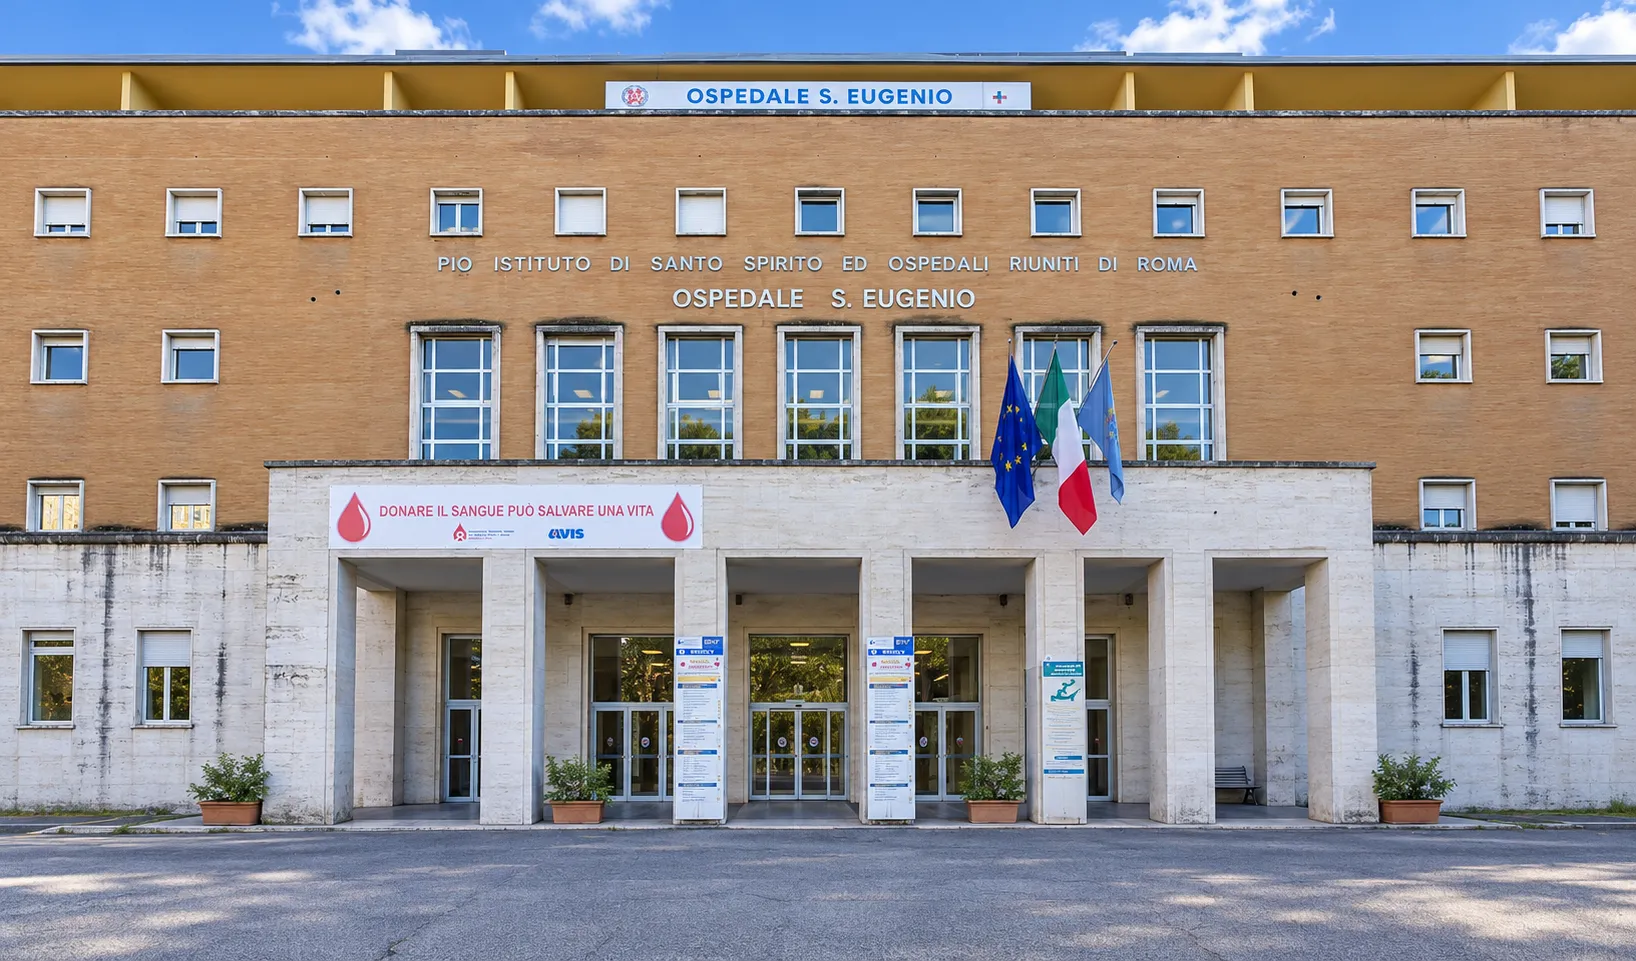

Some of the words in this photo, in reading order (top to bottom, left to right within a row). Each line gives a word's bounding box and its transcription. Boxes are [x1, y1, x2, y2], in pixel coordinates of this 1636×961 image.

[686, 87, 809, 105] OSPEDALE
[819, 87, 839, 105] S.
[848, 87, 953, 105] EUGENIO
[436, 256, 473, 272] PIO
[494, 256, 591, 272] ISTITUTO
[610, 256, 630, 272] DI
[650, 256, 723, 272] SANTO
[743, 256, 823, 272] SPIRITO
[842, 256, 868, 272] ED
[887, 256, 989, 272] OSPEDALI
[1009, 256, 1079, 272] RIUNITI
[1099, 256, 1118, 272] DI
[1137, 256, 1198, 272] ROMA
[672, 288, 804, 308] OSPEDALE
[831, 288, 852, 308] S.
[863, 288, 976, 309] EUGENIO
[379, 505, 433, 517] DONARE
[437, 505, 448, 516] IL
[451, 505, 503, 517] SANGUE
[508, 502, 535, 517] PUÒ
[538, 505, 594, 517] SALVARE
[598, 505, 624, 517] UNA
[627, 505, 654, 516] VITA
[548, 528, 584, 540] AVIS
